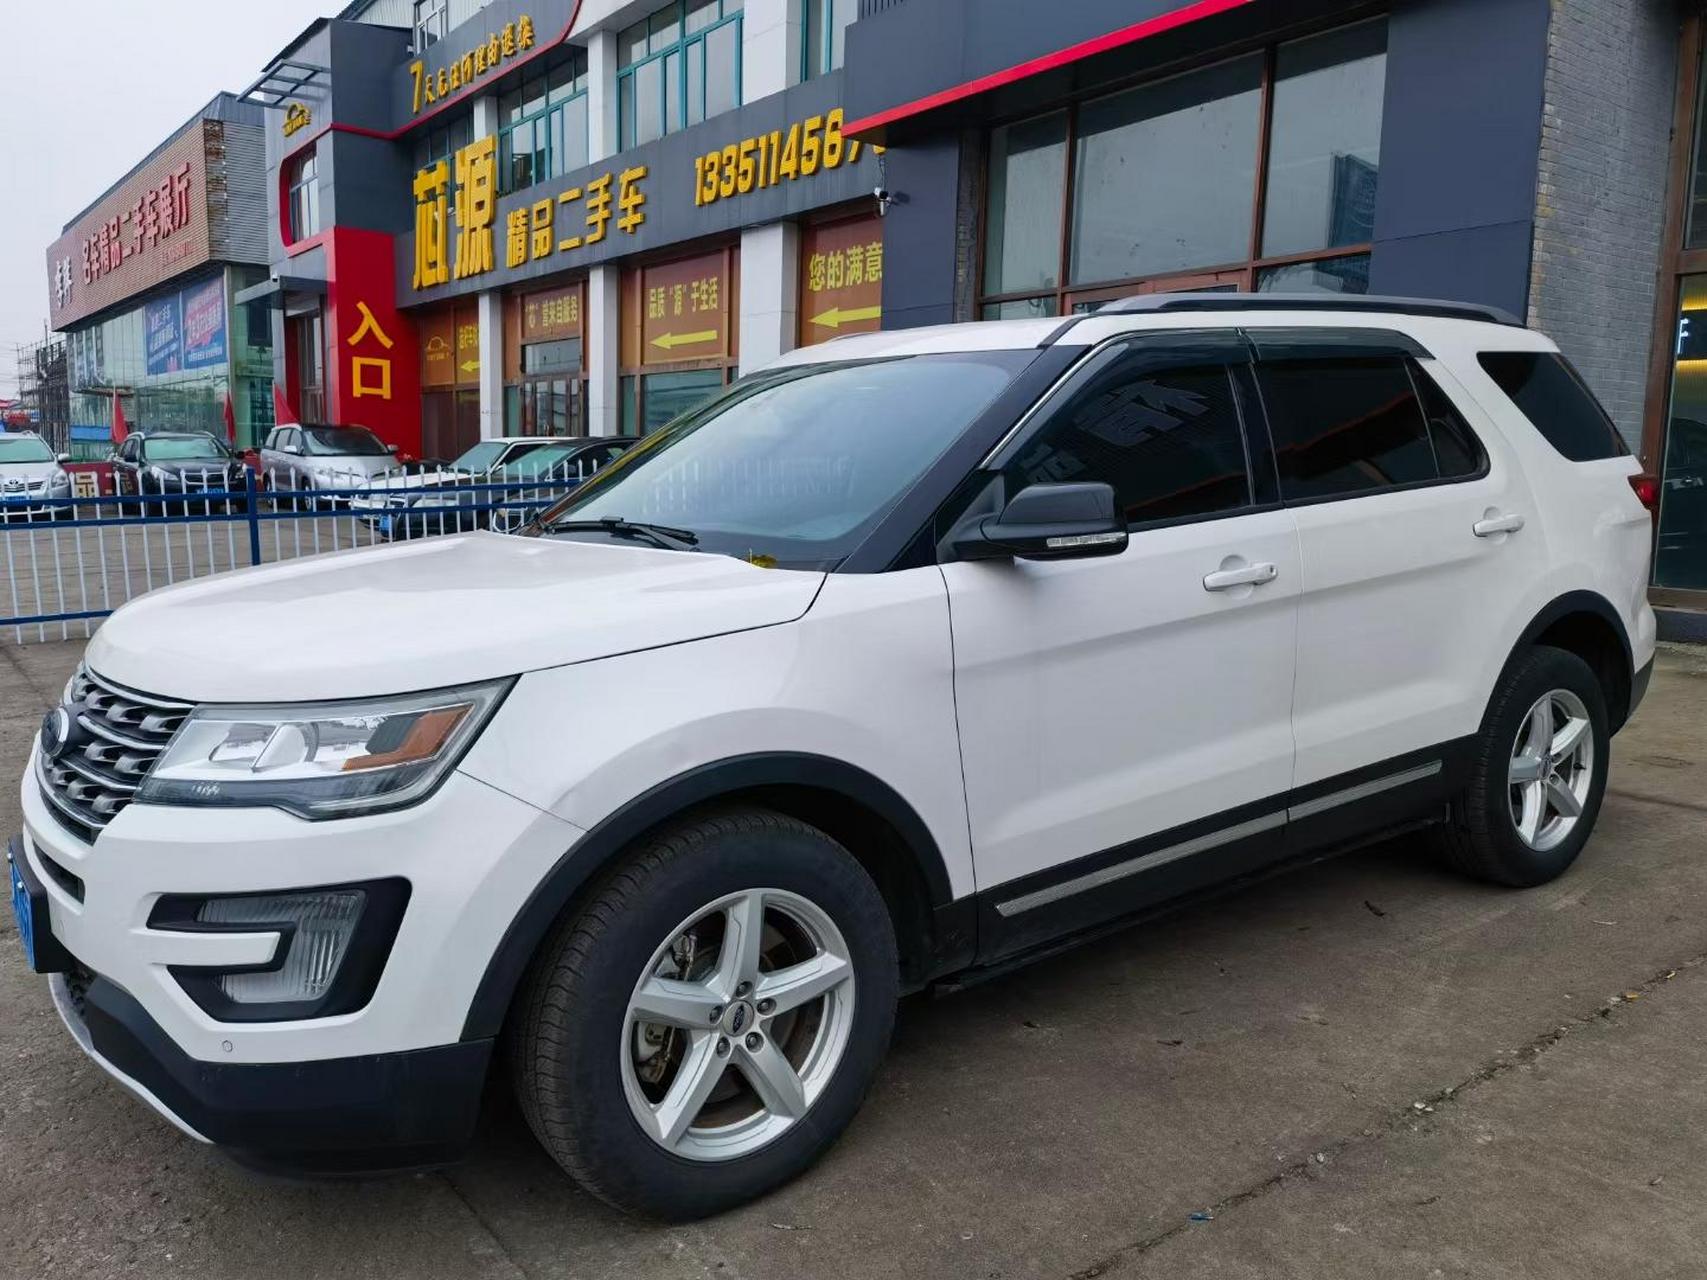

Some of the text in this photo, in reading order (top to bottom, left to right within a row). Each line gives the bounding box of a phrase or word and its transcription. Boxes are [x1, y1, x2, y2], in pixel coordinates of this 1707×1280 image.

[83, 162, 191, 285] 名车精品二手车展厅
[413, 134, 497, 291] 芯源
[506, 166, 648, 268] 精品二手车
[808, 241, 882, 292] 您的满意
[347, 301, 394, 400] 入口
